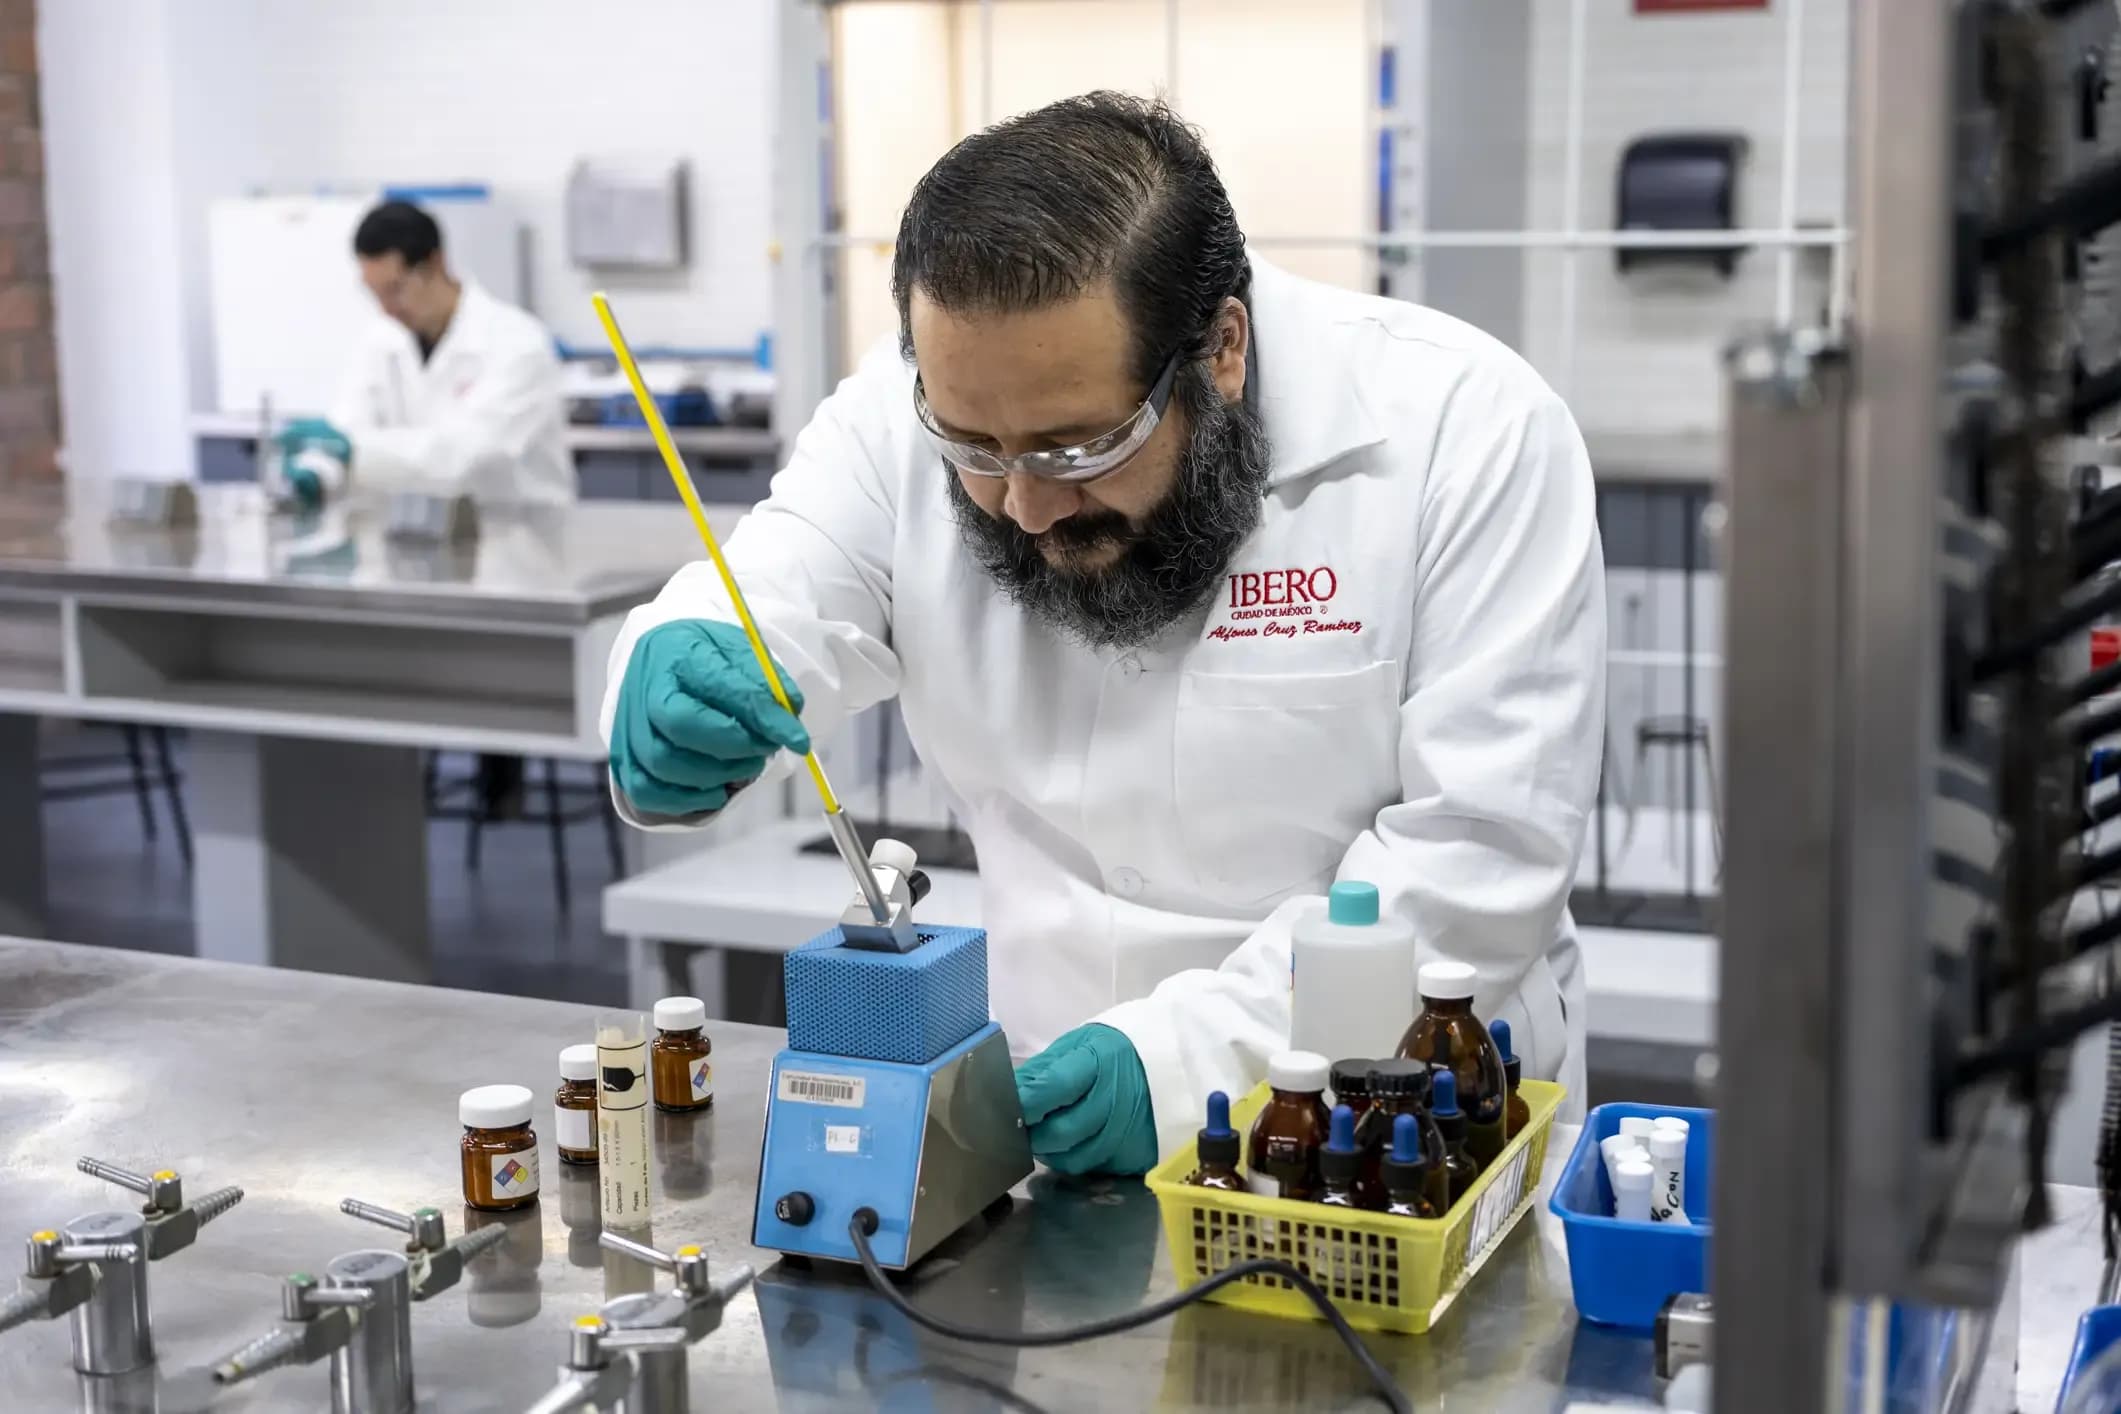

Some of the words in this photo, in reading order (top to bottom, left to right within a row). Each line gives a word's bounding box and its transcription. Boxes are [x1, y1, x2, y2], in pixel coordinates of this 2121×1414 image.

[1228, 566, 1337, 608] IBERO
[1231, 610, 1264, 621] CIUDAD
[1264, 608, 1278, 618] DE
[1278, 604, 1313, 617] MÉXICO
[1207, 625, 1258, 642] Alfonso
[1263, 621, 1298, 639] Cruz
